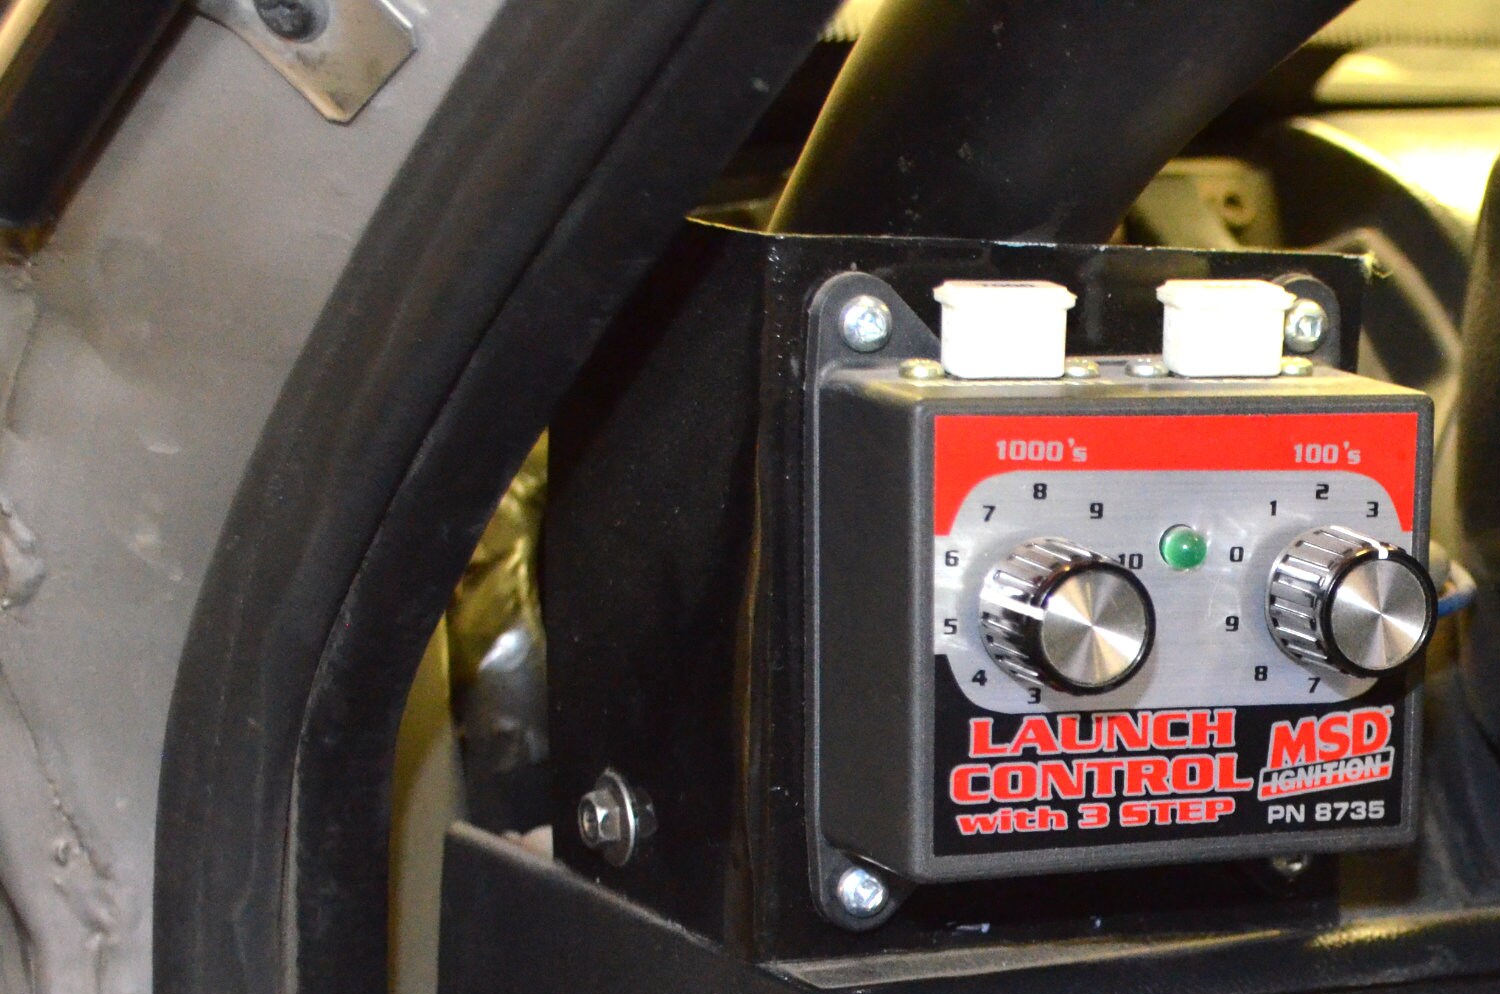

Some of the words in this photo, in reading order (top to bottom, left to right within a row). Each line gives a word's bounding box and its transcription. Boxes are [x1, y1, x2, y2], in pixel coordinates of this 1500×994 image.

[996, 438, 1088, 462] 1000's
[1293, 441, 1361, 464] 100's
[1033, 483, 1047, 499] 8
[1315, 484, 1329, 500] 2
[983, 505, 995, 522] 7
[1089, 503, 1104, 519] 9
[1269, 501, 1278, 516] 1
[1366, 502, 1379, 518] 3
[945, 550, 959, 567] 6
[1118, 553, 1144, 570] 10
[943, 618, 957, 635] 5
[1225, 615, 1239, 632] 9
[971, 669, 987, 686] 4
[1254, 665, 1268, 682] 8
[1307, 676, 1321, 694] 7
[1027, 687, 1042, 704] 3
[967, 708, 1236, 758] LAUNCH
[1267, 706, 1393, 770] MSD
[949, 754, 1254, 804] CONTROL
[1270, 753, 1383, 794] IGNITION
[956, 806, 1068, 836] with
[1077, 802, 1110, 829] 3
[1119, 797, 1236, 826] STEP
[1267, 804, 1306, 825] PN
[1314, 800, 1386, 823] 8735
